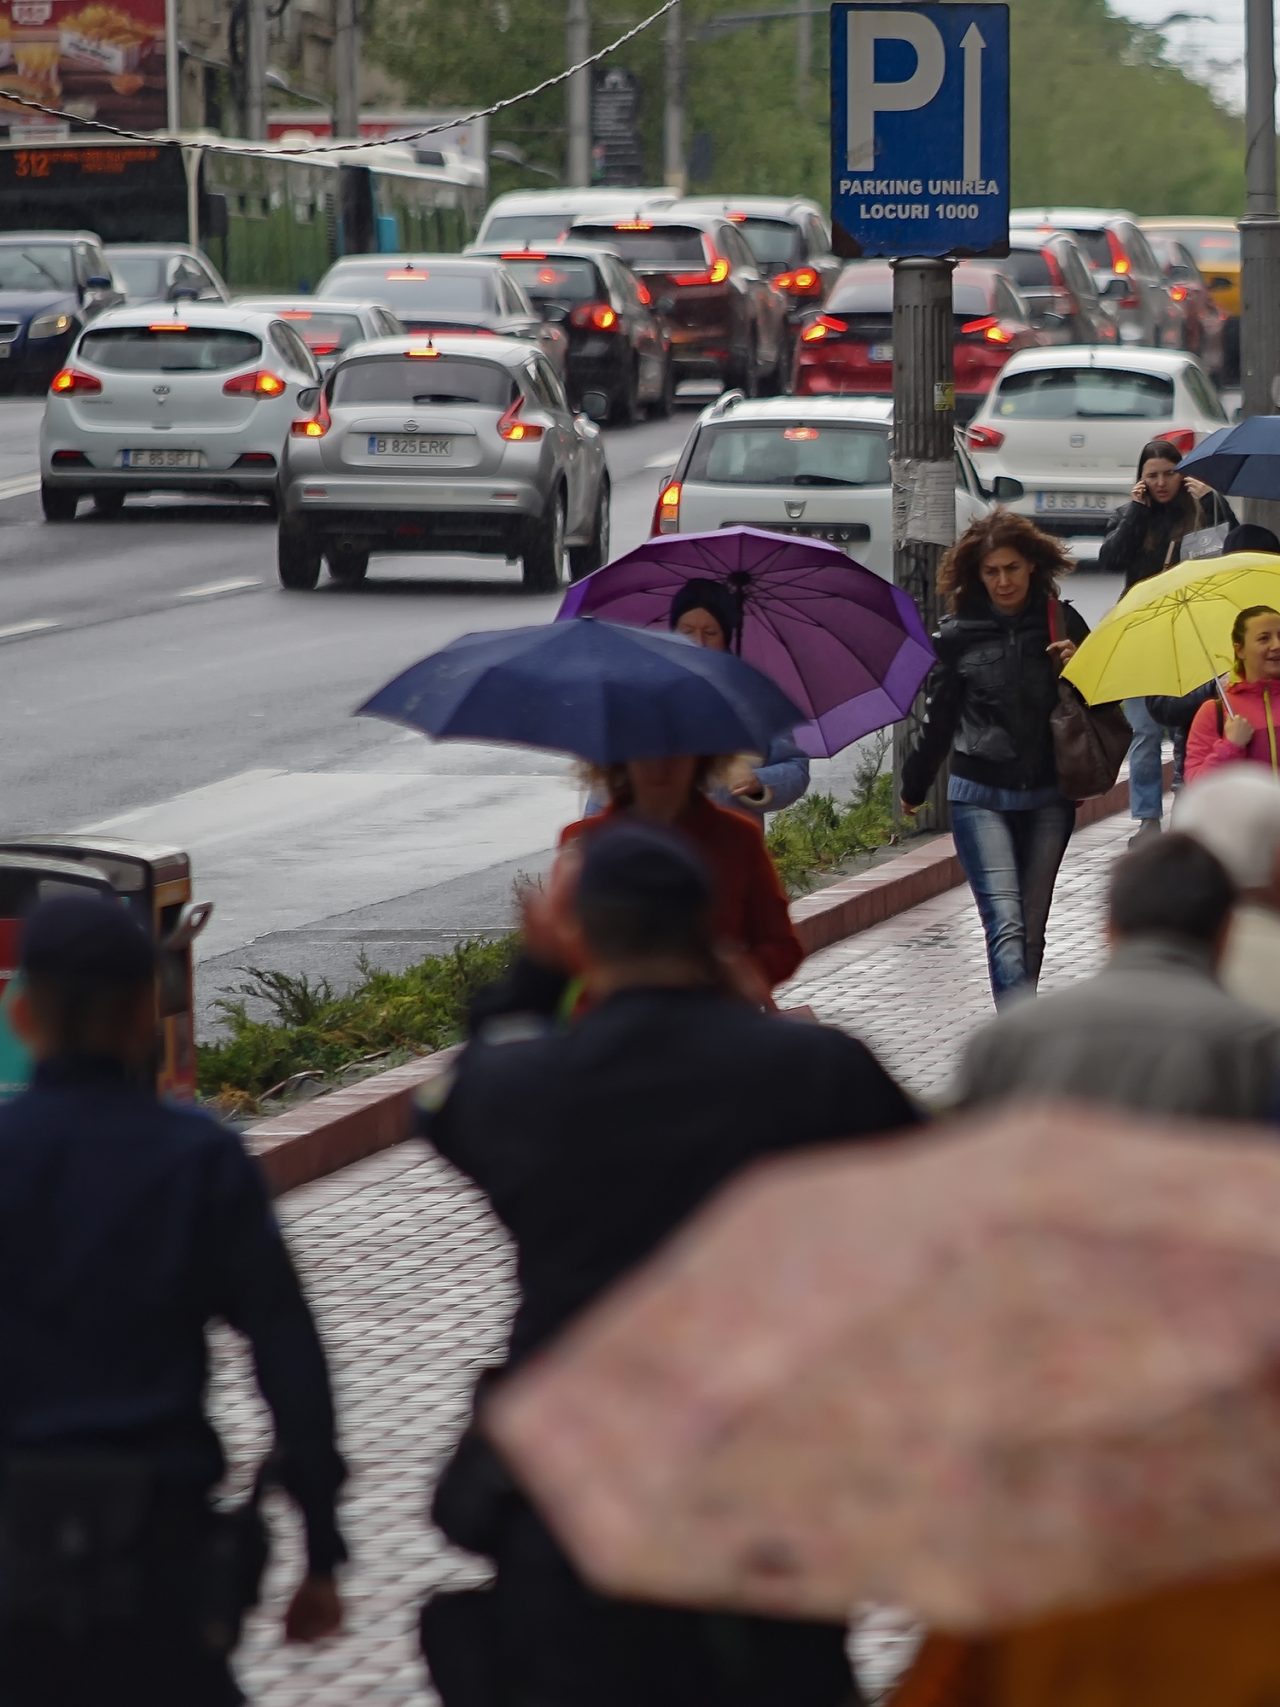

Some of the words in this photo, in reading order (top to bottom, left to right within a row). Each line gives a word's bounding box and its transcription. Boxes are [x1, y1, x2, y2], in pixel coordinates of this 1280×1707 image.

[847, 10, 945, 172] P
[839, 180, 923, 195] PARKING
[928, 180, 999, 195] UNIREA
[860, 204, 929, 219] LOCURI
[935, 204, 979, 219] 1000
[376, 441, 386, 453] B
[391, 440, 417, 453] 825
[419, 440, 449, 454] ERK
